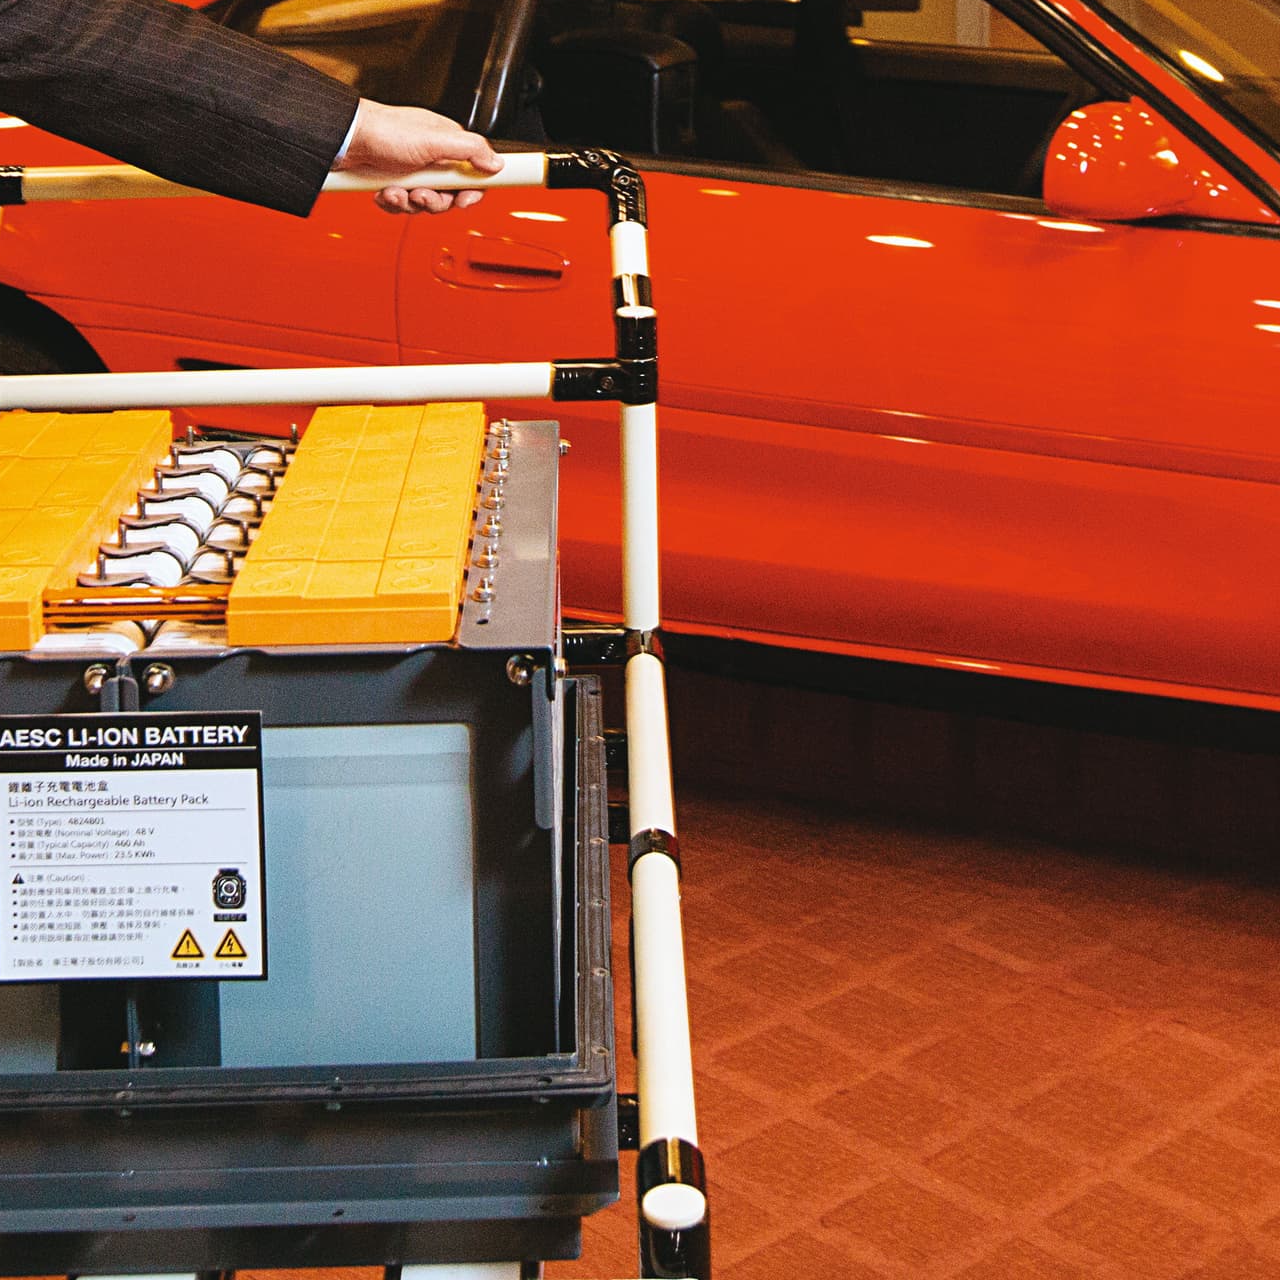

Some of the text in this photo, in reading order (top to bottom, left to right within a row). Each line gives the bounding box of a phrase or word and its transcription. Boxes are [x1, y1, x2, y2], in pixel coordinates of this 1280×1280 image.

[0, 725, 248, 748] AESC LI-ION BATTERY
[65, 752, 184, 768] Made in JAPAN
[8, 793, 209, 810] Li-ion Rechargeable Battery Pack
